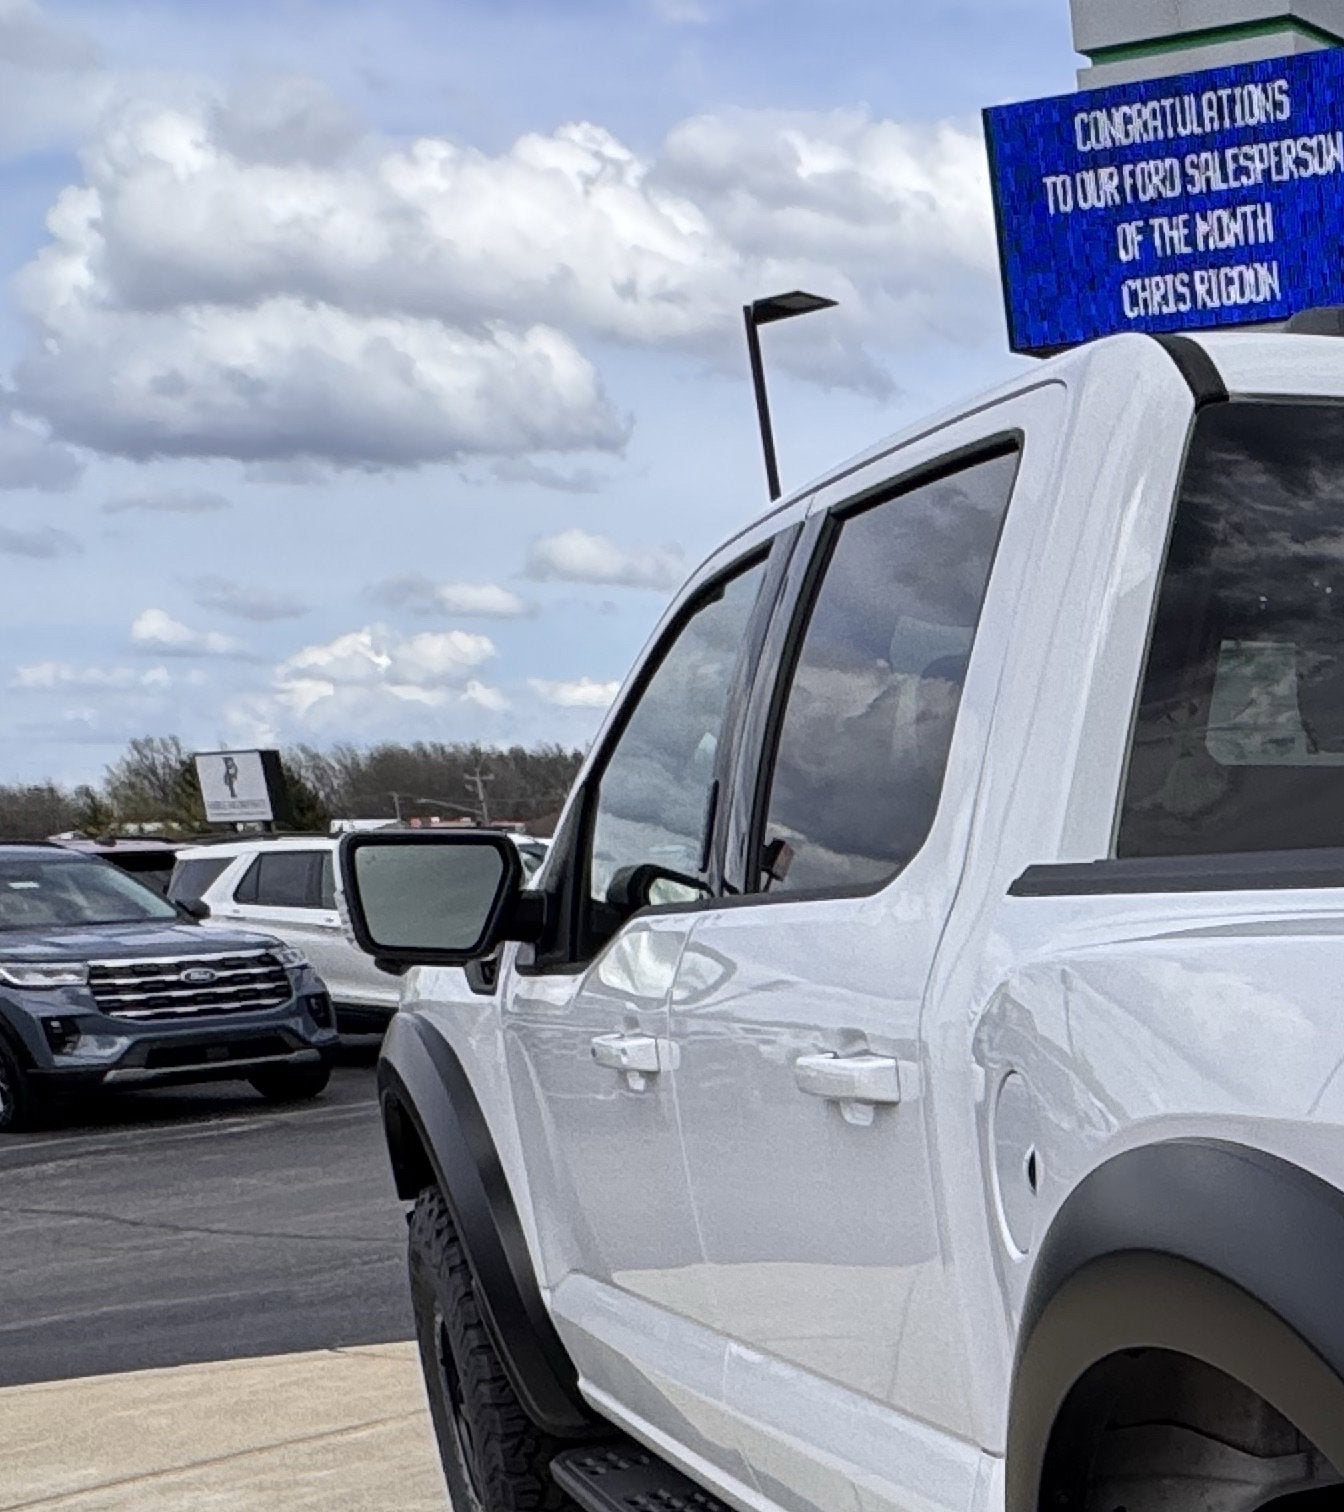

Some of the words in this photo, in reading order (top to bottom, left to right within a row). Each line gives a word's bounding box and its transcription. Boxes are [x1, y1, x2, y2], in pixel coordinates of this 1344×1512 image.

[1074, 79, 1290, 152] CONGRATULATIONS
[1043, 175, 1074, 217] TO
[1076, 167, 1121, 211] OUR
[1123, 157, 1182, 203] FORD
[1116, 220, 1144, 262] OF
[1149, 213, 1193, 257] THE
[1196, 202, 1275, 251] MONTH
[1121, 272, 1192, 319] CHRIS
